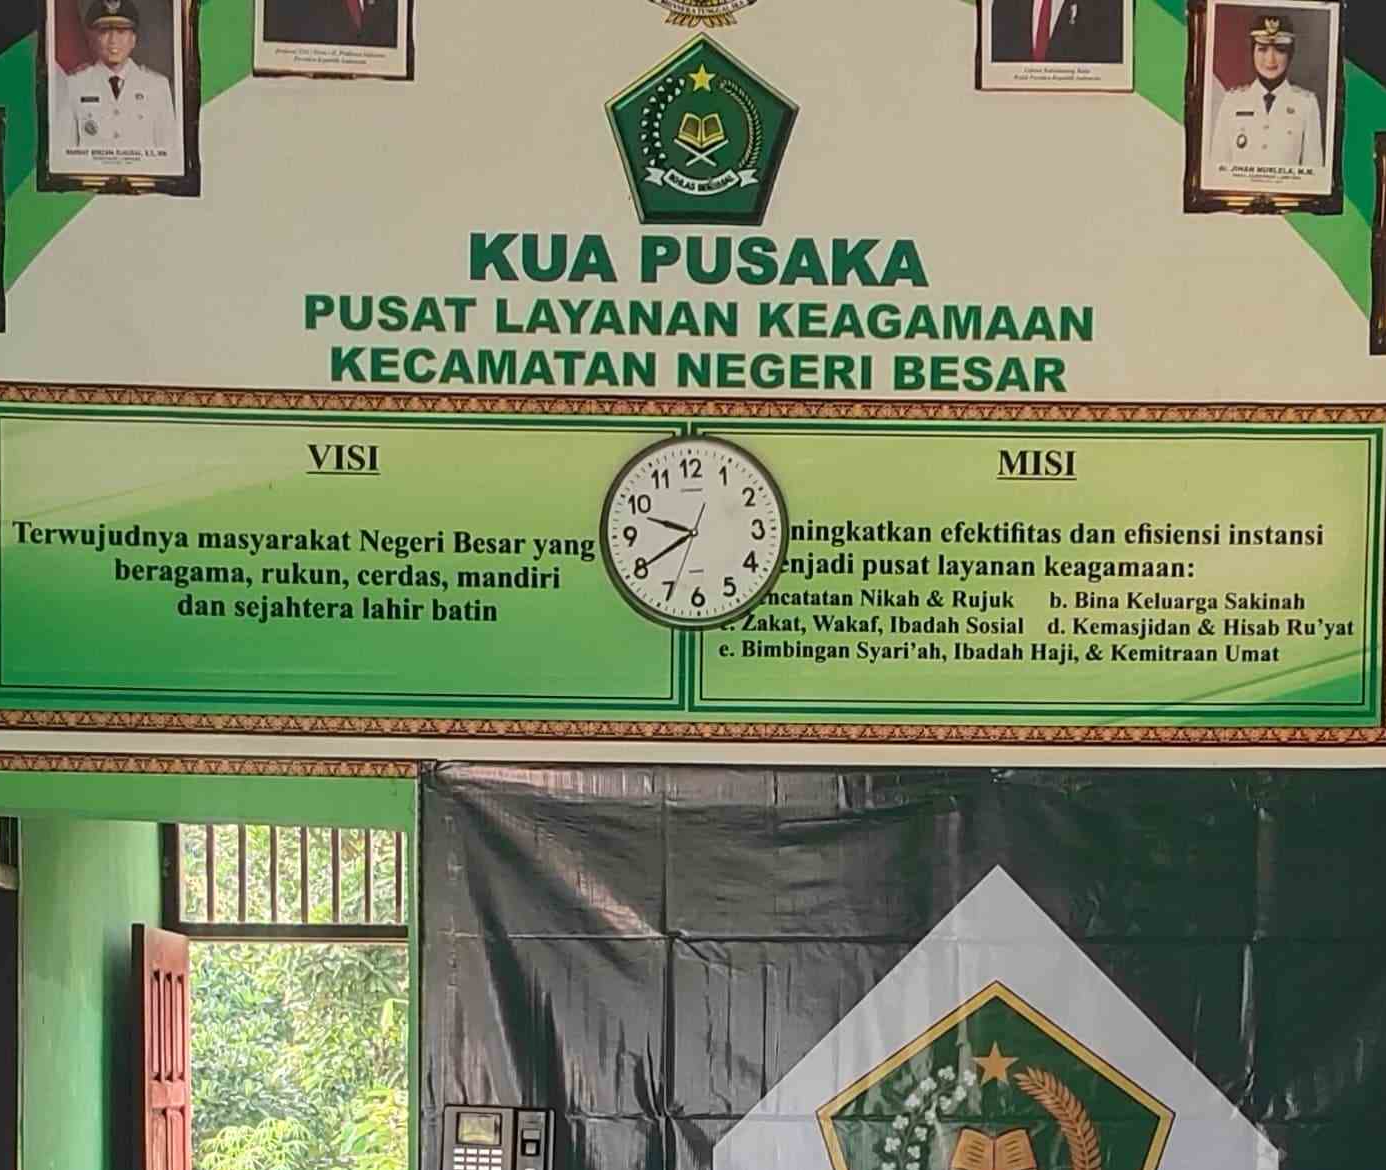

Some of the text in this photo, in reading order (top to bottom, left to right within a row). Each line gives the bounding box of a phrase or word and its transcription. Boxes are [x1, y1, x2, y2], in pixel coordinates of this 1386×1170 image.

[469, 232, 930, 288] KUA PUSAKA
[304, 294, 1094, 342] PUSAT LAYANAN KEAGAMAAN
[330, 346, 1068, 394] KECAMATAN NEGERI BESAR
[307, 444, 381, 473] VISI
[679, 458, 703, 479] 12
[997, 449, 1078, 478] MISI
[650, 469, 671, 490] 11
[718, 465, 729, 487] 1
[627, 494, 652, 515] 10
[741, 487, 757, 507] 2
[13, 519, 596, 563] Terwujudnya masyarakat Negeri Besar yang
[622, 525, 638, 547] 9
[750, 518, 766, 541] 3
[790, 519, 1325, 548] ningkatkan efektifitas dan efisiensi instansi
[633, 557, 649, 580] 8
[742, 550, 760, 573] 4
[781, 552, 1196, 583] enjadi pusat layanan keagamaan:
[114, 558, 561, 592] beragama, rukun, cerdas, mandiri
[722, 576, 737, 598] 5
[661, 581, 676, 602] 7
[690, 586, 706, 608] 6
[860, 588, 923, 609] Nikah
[926, 591, 945, 609] &
[951, 591, 1016, 613] Rujuk
[1050, 591, 1068, 610] b.
[1075, 592, 1120, 610] Bina
[1126, 592, 1219, 615] Keluarga
[1224, 592, 1306, 611] Sakinah
[177, 594, 499, 623] dan sejahtera lahir batin
[741, 614, 807, 636] Zakat,
[813, 614, 885, 636] Wakaf,
[889, 615, 960, 635] Ibadah
[965, 615, 1025, 635] Sosial
[1047, 617, 1066, 636] d.
[1072, 618, 1192, 641] Kemasjidan
[1197, 619, 1218, 637] &
[1223, 618, 1281, 637] Hisab
[719, 644, 735, 659] e.
[741, 640, 851, 664] Bimbingan
[954, 642, 1024, 661] Ibadah
[1030, 642, 1080, 666] Haji,
[1085, 644, 1104, 662] &
[1110, 643, 1219, 663] Kemitraan
[1225, 644, 1280, 663] Umat
